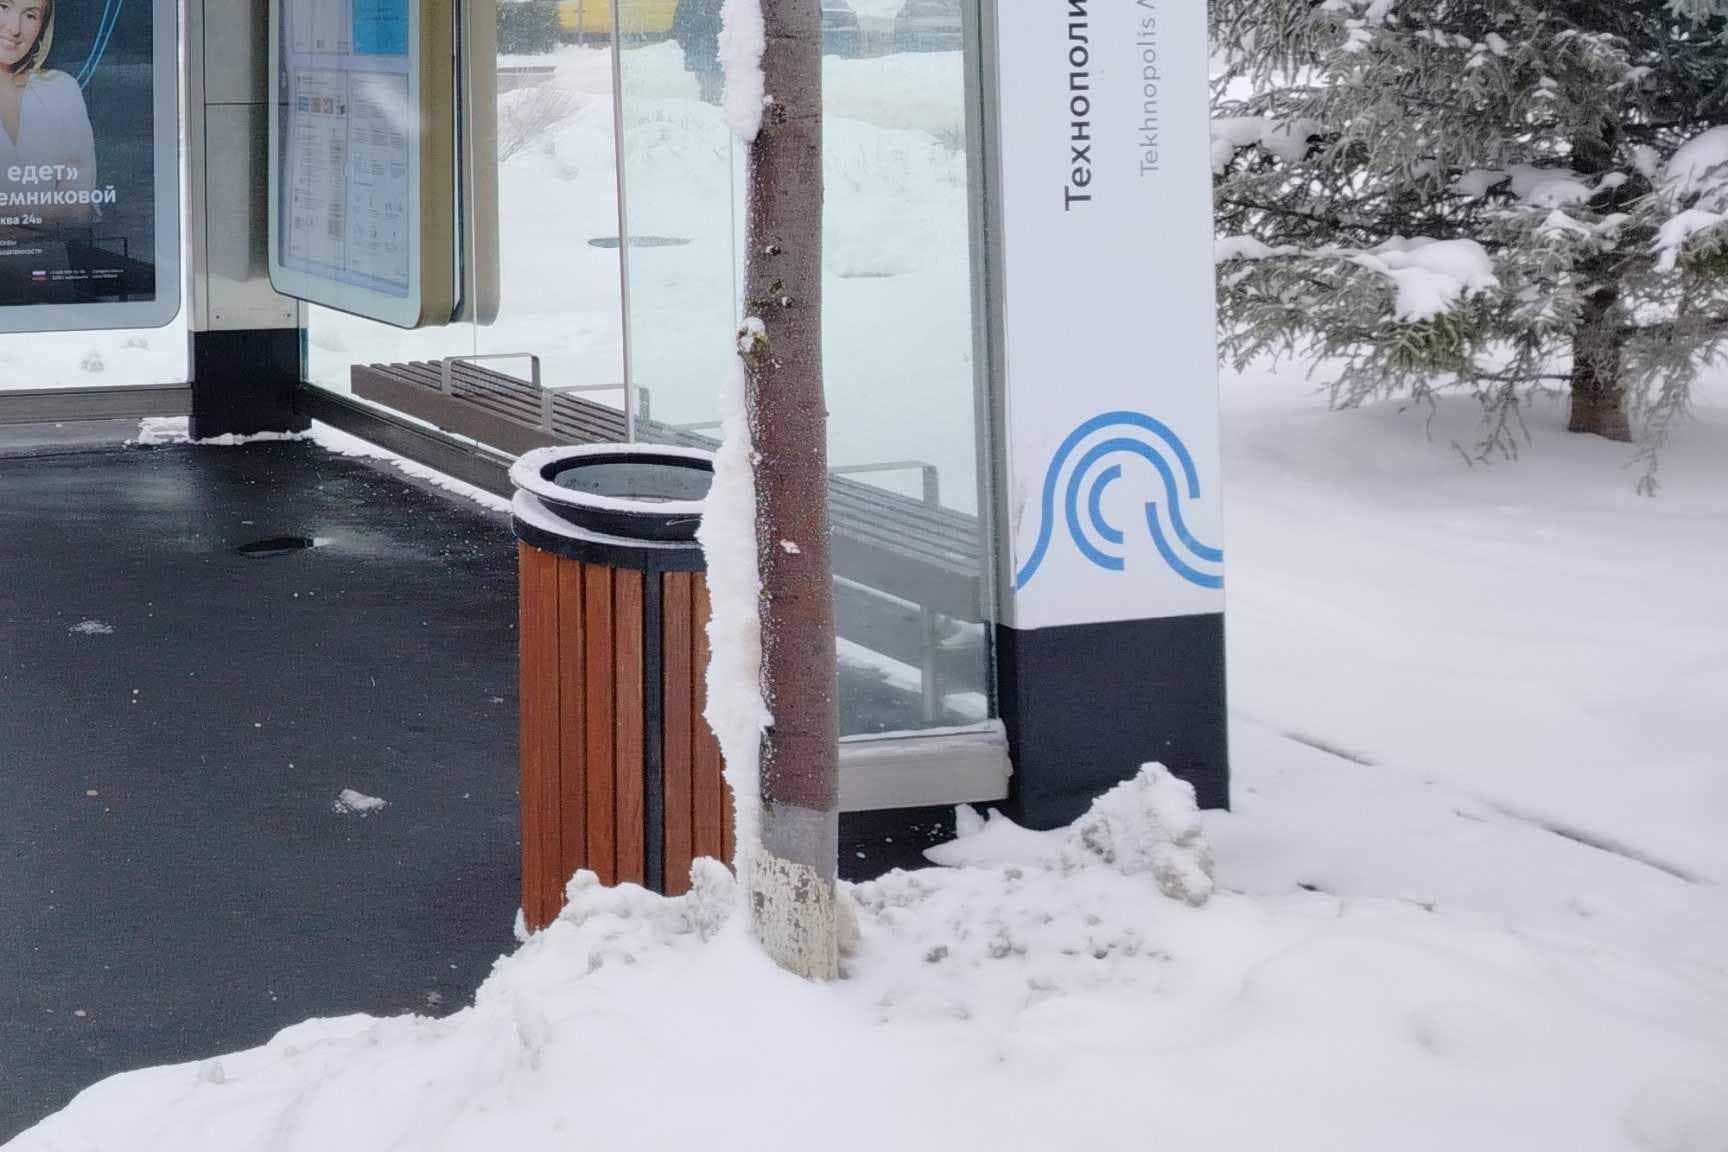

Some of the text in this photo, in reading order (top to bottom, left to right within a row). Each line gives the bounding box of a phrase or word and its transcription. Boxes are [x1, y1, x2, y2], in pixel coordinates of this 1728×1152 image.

[1137, 17, 1160, 177] Tekhnopolis
[7, 163, 79, 184] едет»
[22, 214, 43, 226] 24»
